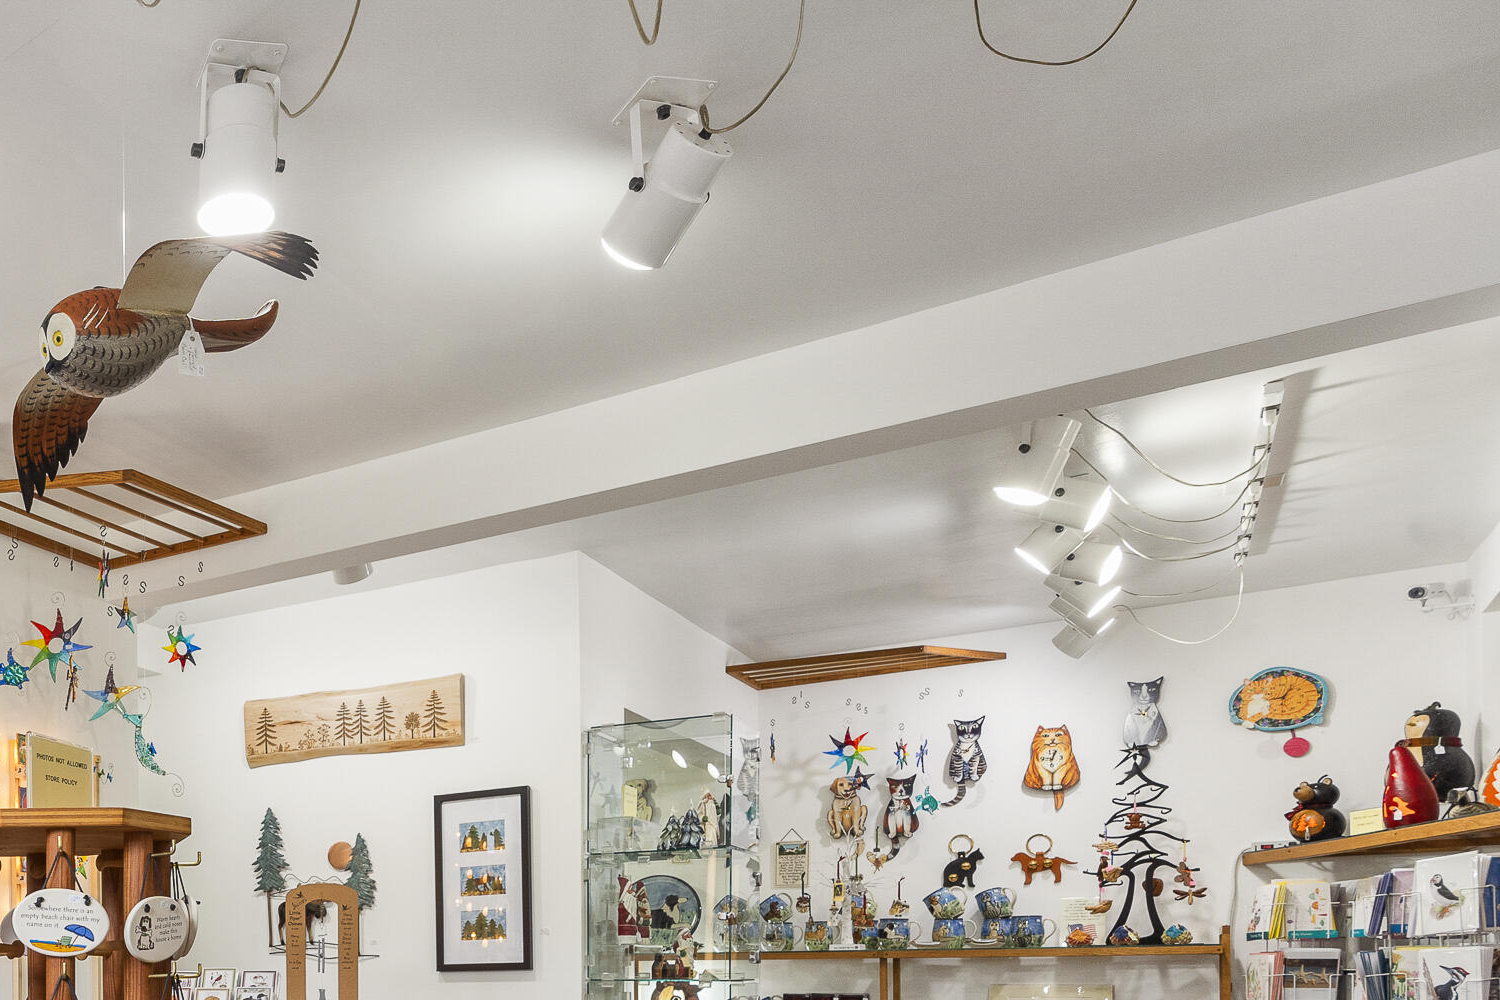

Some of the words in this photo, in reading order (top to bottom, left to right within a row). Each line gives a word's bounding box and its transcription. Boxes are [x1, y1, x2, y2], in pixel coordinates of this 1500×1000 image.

[36, 752, 54, 762] PHOTOS
[55, 757, 65, 765] NOT
[66, 760, 88, 770] ALLOWED
[45, 774, 60, 783] STORE
[61, 778, 78, 786] POLICY
